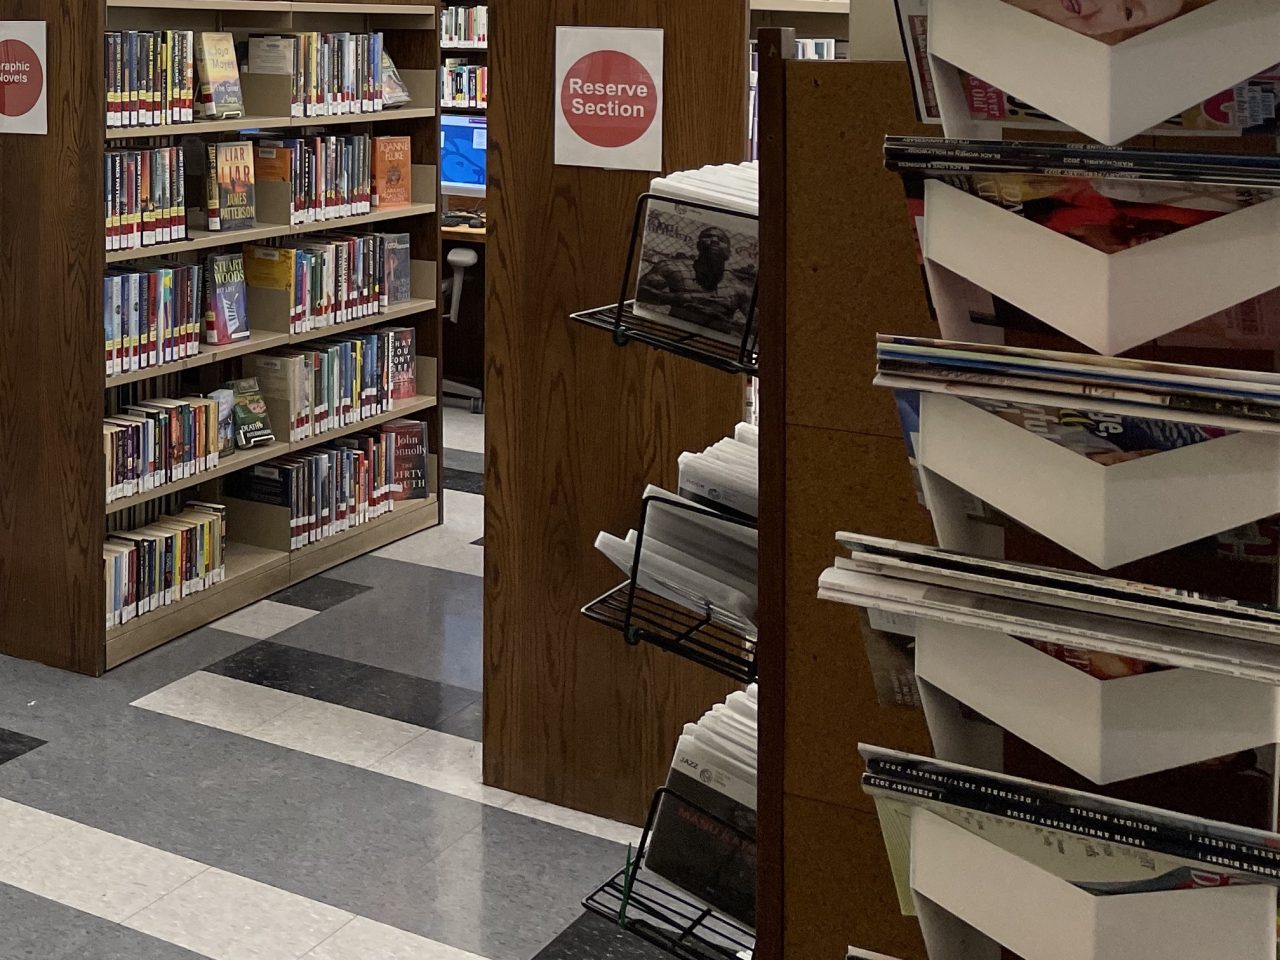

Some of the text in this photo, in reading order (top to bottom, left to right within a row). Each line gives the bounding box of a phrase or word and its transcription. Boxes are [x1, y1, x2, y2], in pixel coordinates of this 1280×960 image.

[213, 47, 228, 57] Jojo
[570, 78, 648, 96] Reserve
[572, 98, 644, 117] Section
[380, 142, 409, 152] JOANNE
[224, 148, 245, 162] LIAR
[385, 151, 404, 160] FLUKE
[1083, 158, 1134, 167] MARCH/APRIL
[222, 165, 250, 183] LIAR
[227, 192, 247, 205] JAMES
[220, 206, 255, 220] PATTERSON
[214, 258, 244, 272] STUART
[214, 270, 245, 284] WOODS
[395, 338, 412, 348] HAT
[394, 354, 410, 363] ON'T
[397, 434, 418, 446] John
[394, 444, 426, 456] onnolly
[396, 480, 426, 488] OUTH
[680, 756, 699, 770] JAZZ
[892, 783, 933, 798] FEBRUARY
[980, 786, 1032, 804] DECEMBER
[1069, 807, 1158, 832] HOLIDAY ANGELS
[1006, 809, 1145, 847] 100TH ANNIVERSARY ISSUE
[1198, 834, 1237, 851] DIGEST
[1206, 854, 1280, 877] EADER'S DIGEST
